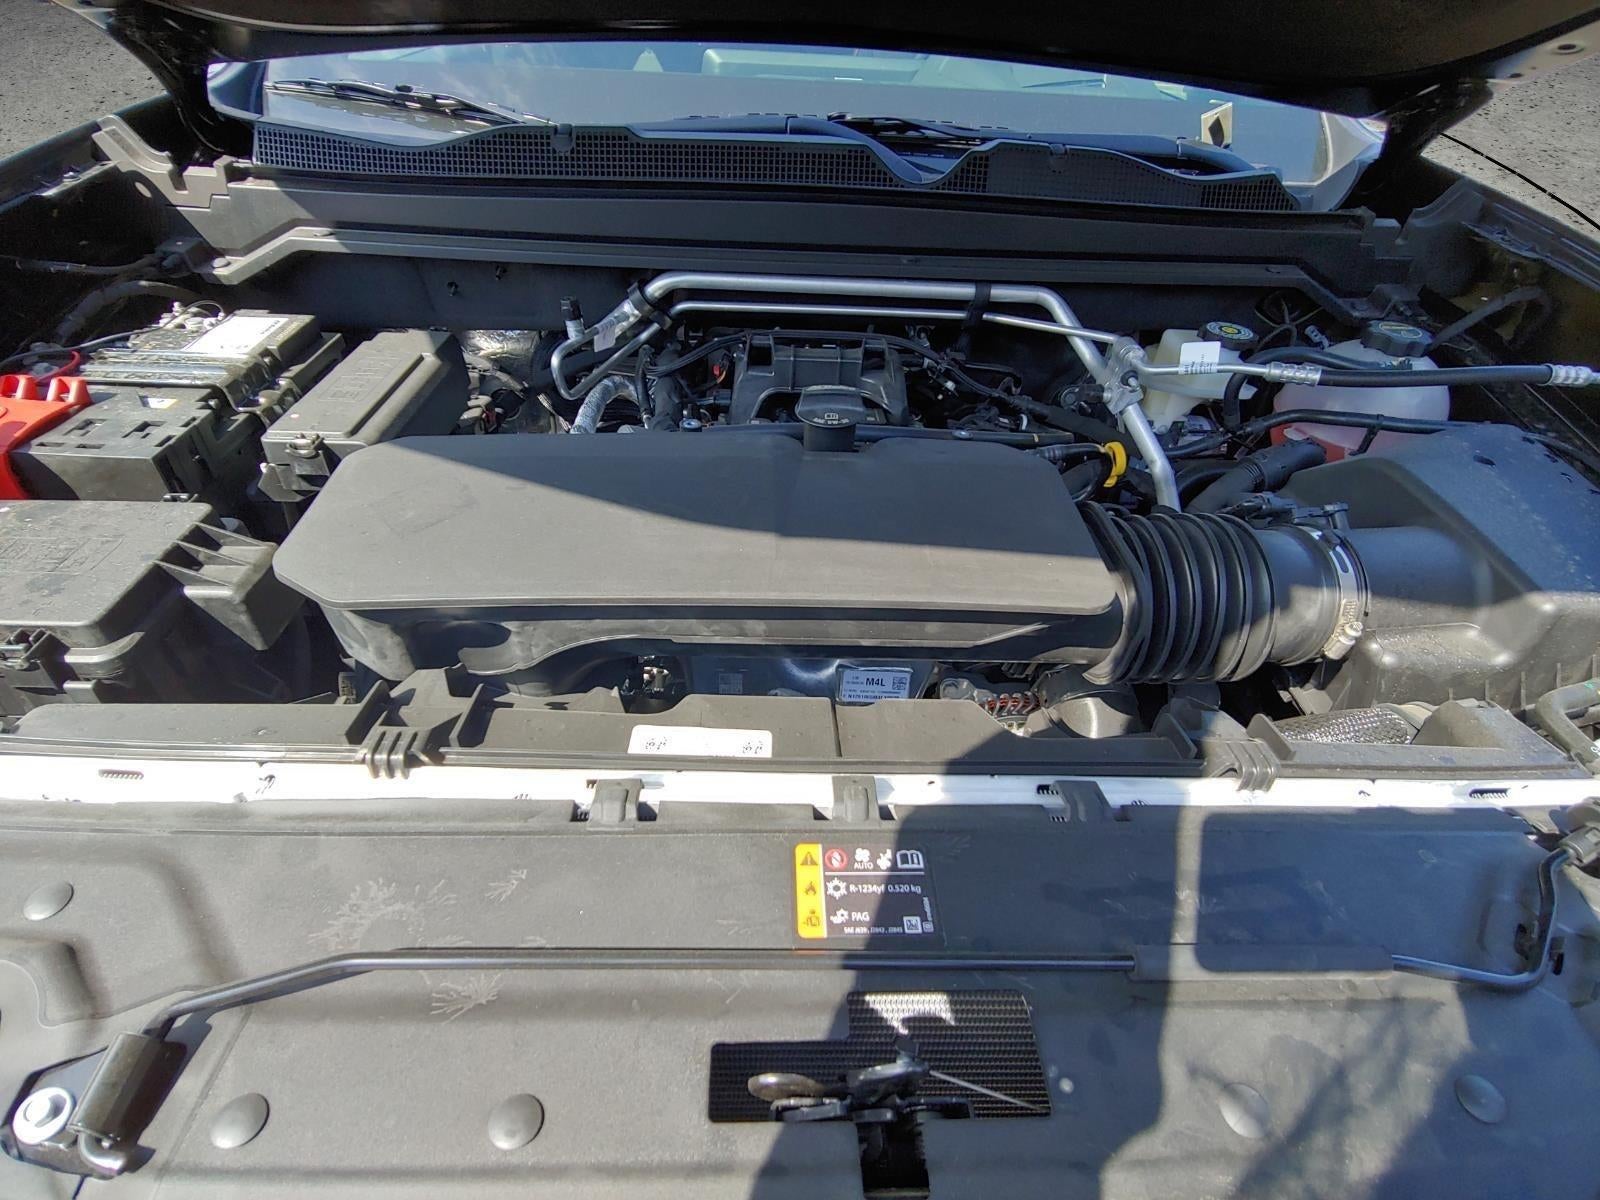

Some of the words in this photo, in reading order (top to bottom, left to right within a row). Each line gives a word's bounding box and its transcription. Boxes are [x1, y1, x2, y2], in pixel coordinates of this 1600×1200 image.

[866, 678, 886, 686] M4L
[854, 862, 874, 870] AUTO
[850, 883, 885, 895] R-1234yf
[887, 883, 910, 893] 0.520
[911, 883, 921, 894] kg
[851, 911, 870, 921] PAG
